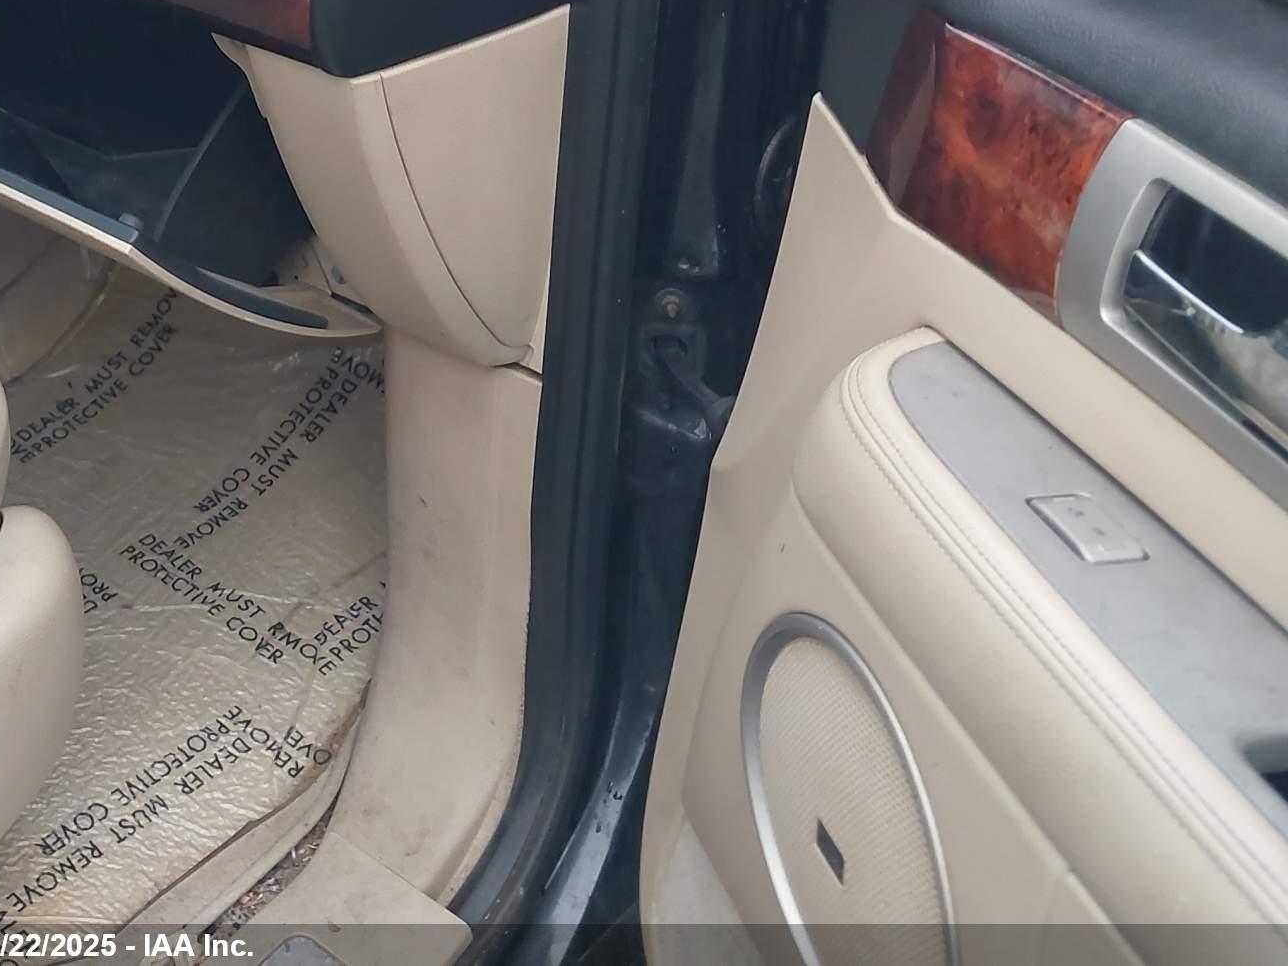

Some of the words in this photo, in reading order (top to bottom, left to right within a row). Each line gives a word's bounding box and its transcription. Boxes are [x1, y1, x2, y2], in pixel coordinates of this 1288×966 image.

[32, 379, 128, 453] PROTECTIVE
[129, 325, 177, 376] COVER
[84, 352, 128, 394] MUST
[250, 367, 339, 465] PROTECTIVE
[299, 379, 357, 442] DEALER
[192, 468, 250, 512] COVER
[251, 448, 298, 496] MUST
[173, 498, 248, 549] REMOVE
[119, 545, 225, 616] PROTECTIVE
[226, 617, 283, 664] COVER
[138, 533, 202, 580] DEALER
[205, 582, 266, 618] MUST
[111, 716, 230, 806] PROTECTIVE
[173, 737, 252, 796] DEALER
[222, 706, 304, 778] REMOVE
[34, 803, 109, 858] COVER
[109, 795, 169, 844] MUST
[5, 840, 103, 912] REMOVE
